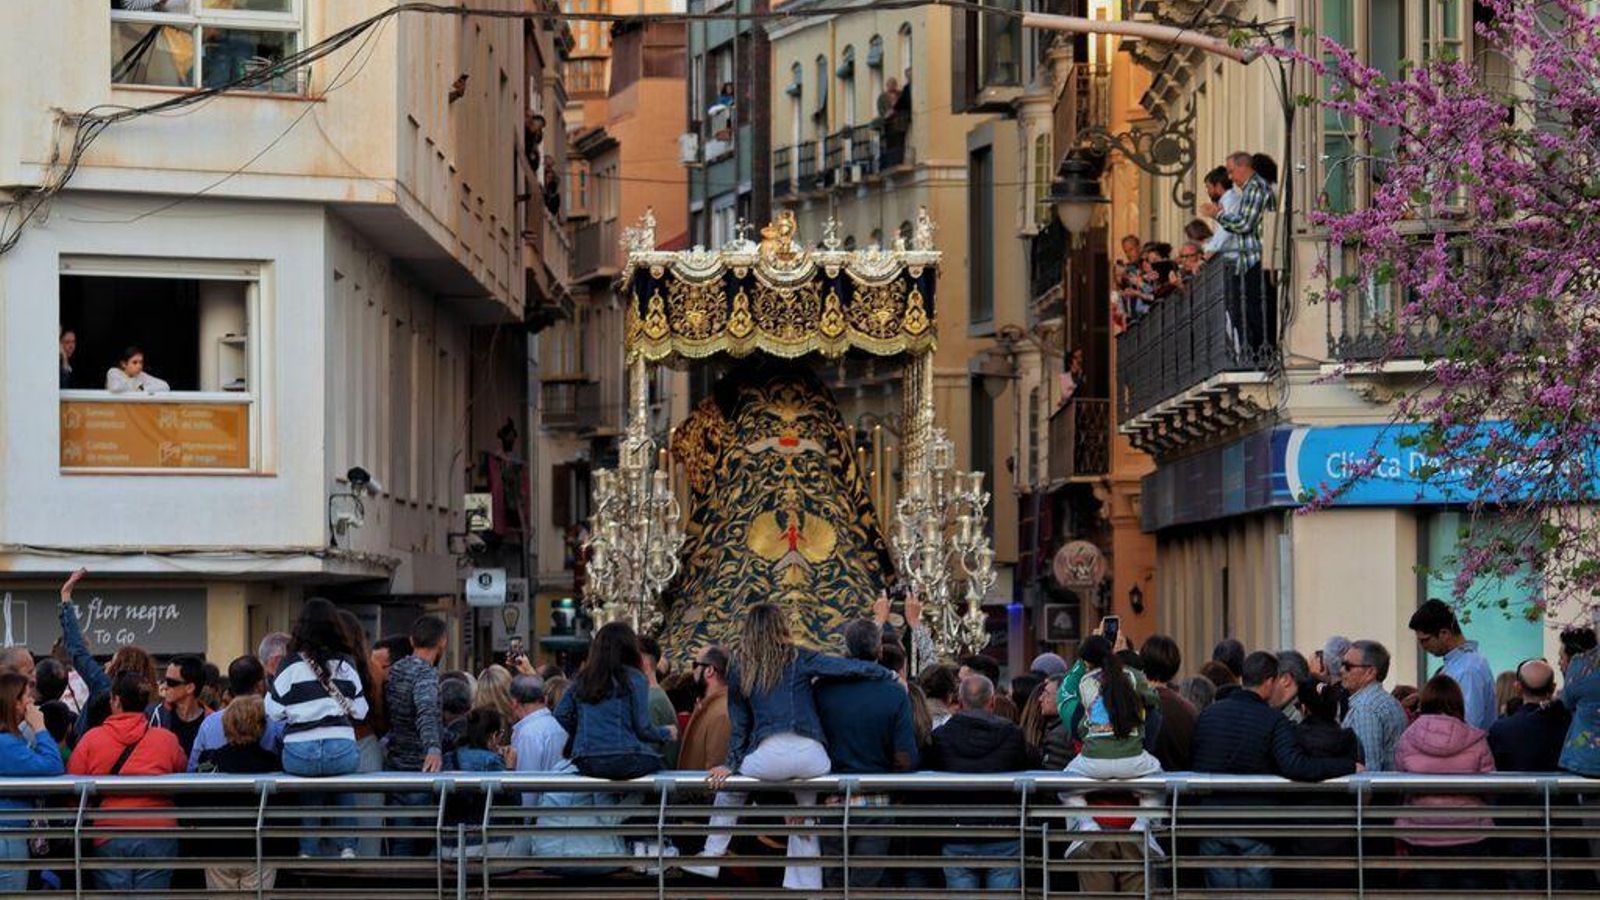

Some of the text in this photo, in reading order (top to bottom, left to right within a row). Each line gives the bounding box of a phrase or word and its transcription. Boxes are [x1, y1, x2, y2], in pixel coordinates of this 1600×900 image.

[83, 597, 121, 633] flor
[126, 604, 180, 633] negra
[116, 628, 135, 645] Go
